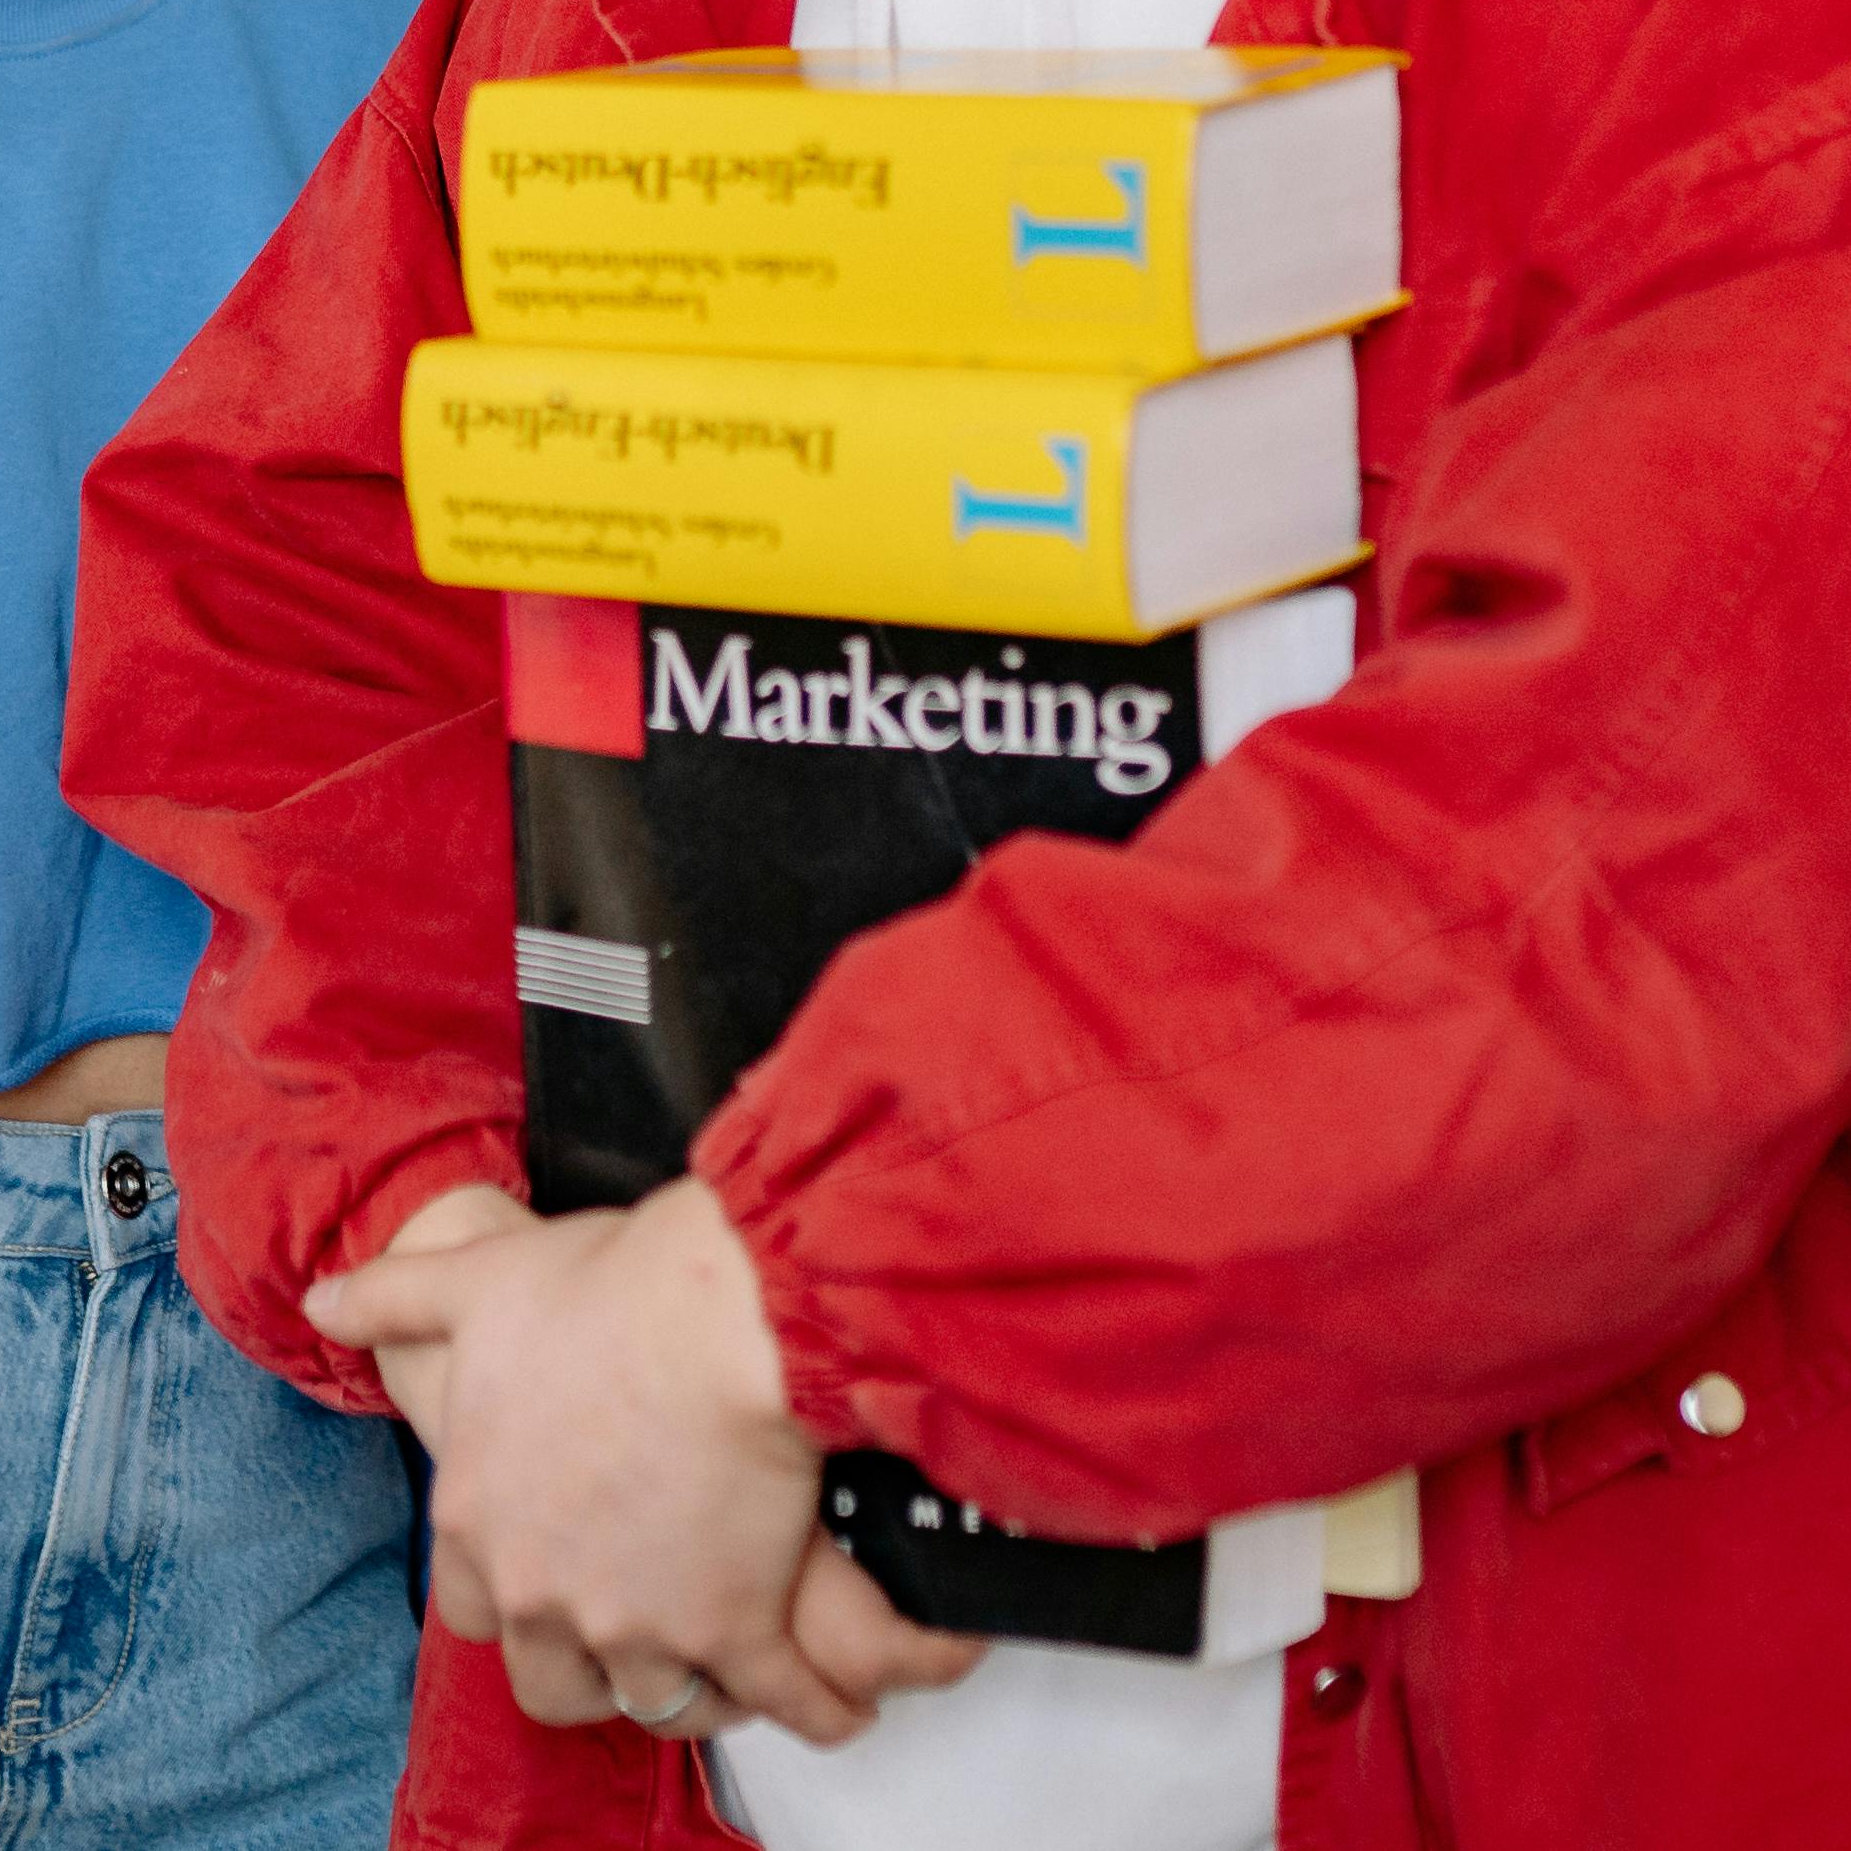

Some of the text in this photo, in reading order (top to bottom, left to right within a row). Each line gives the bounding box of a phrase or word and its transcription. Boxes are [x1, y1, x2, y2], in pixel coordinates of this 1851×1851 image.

[491, 140, 890, 208] Englisch-Deutsch
[1012, 160, 1147, 270] L
[442, 391, 834, 475] Deutsch-Englisch
[953, 436, 1089, 550] L
[646, 628, 1172, 796] Marketing
